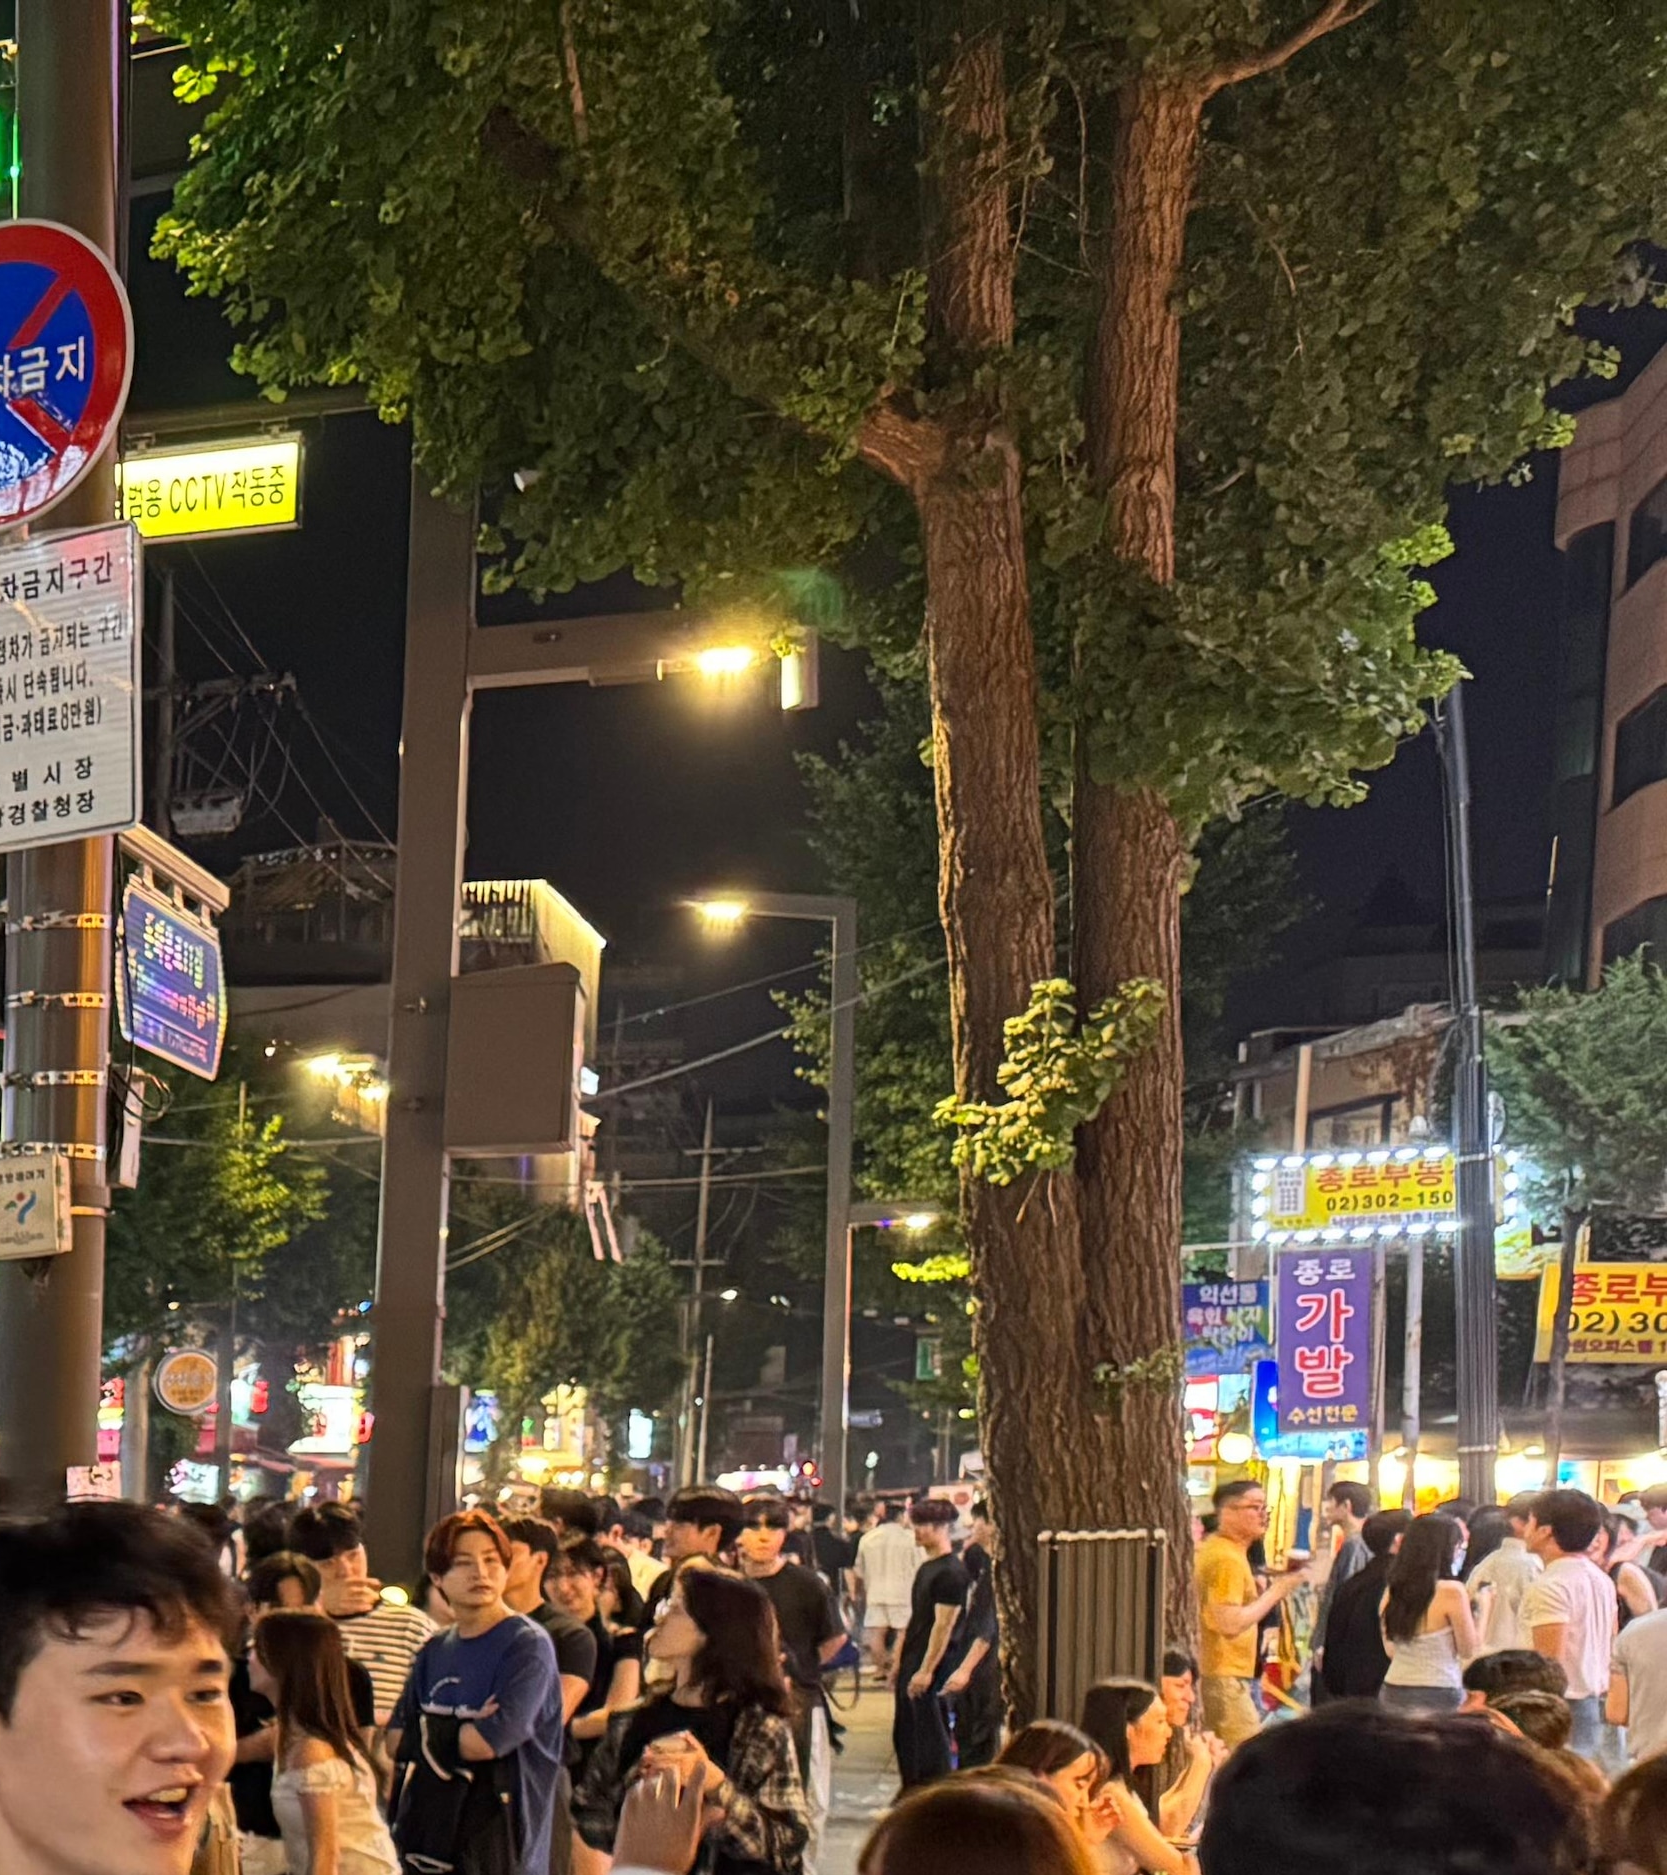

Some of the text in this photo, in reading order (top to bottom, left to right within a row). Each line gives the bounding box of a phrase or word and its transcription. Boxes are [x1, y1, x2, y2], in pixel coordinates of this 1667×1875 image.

[170, 473, 226, 513] CCTV
[231, 465, 285, 508] 작동중
[1316, 1160, 1455, 1194] 종로부동
[1293, 1258, 1356, 1287] 종로
[1295, 1288, 1355, 1398] 가발
